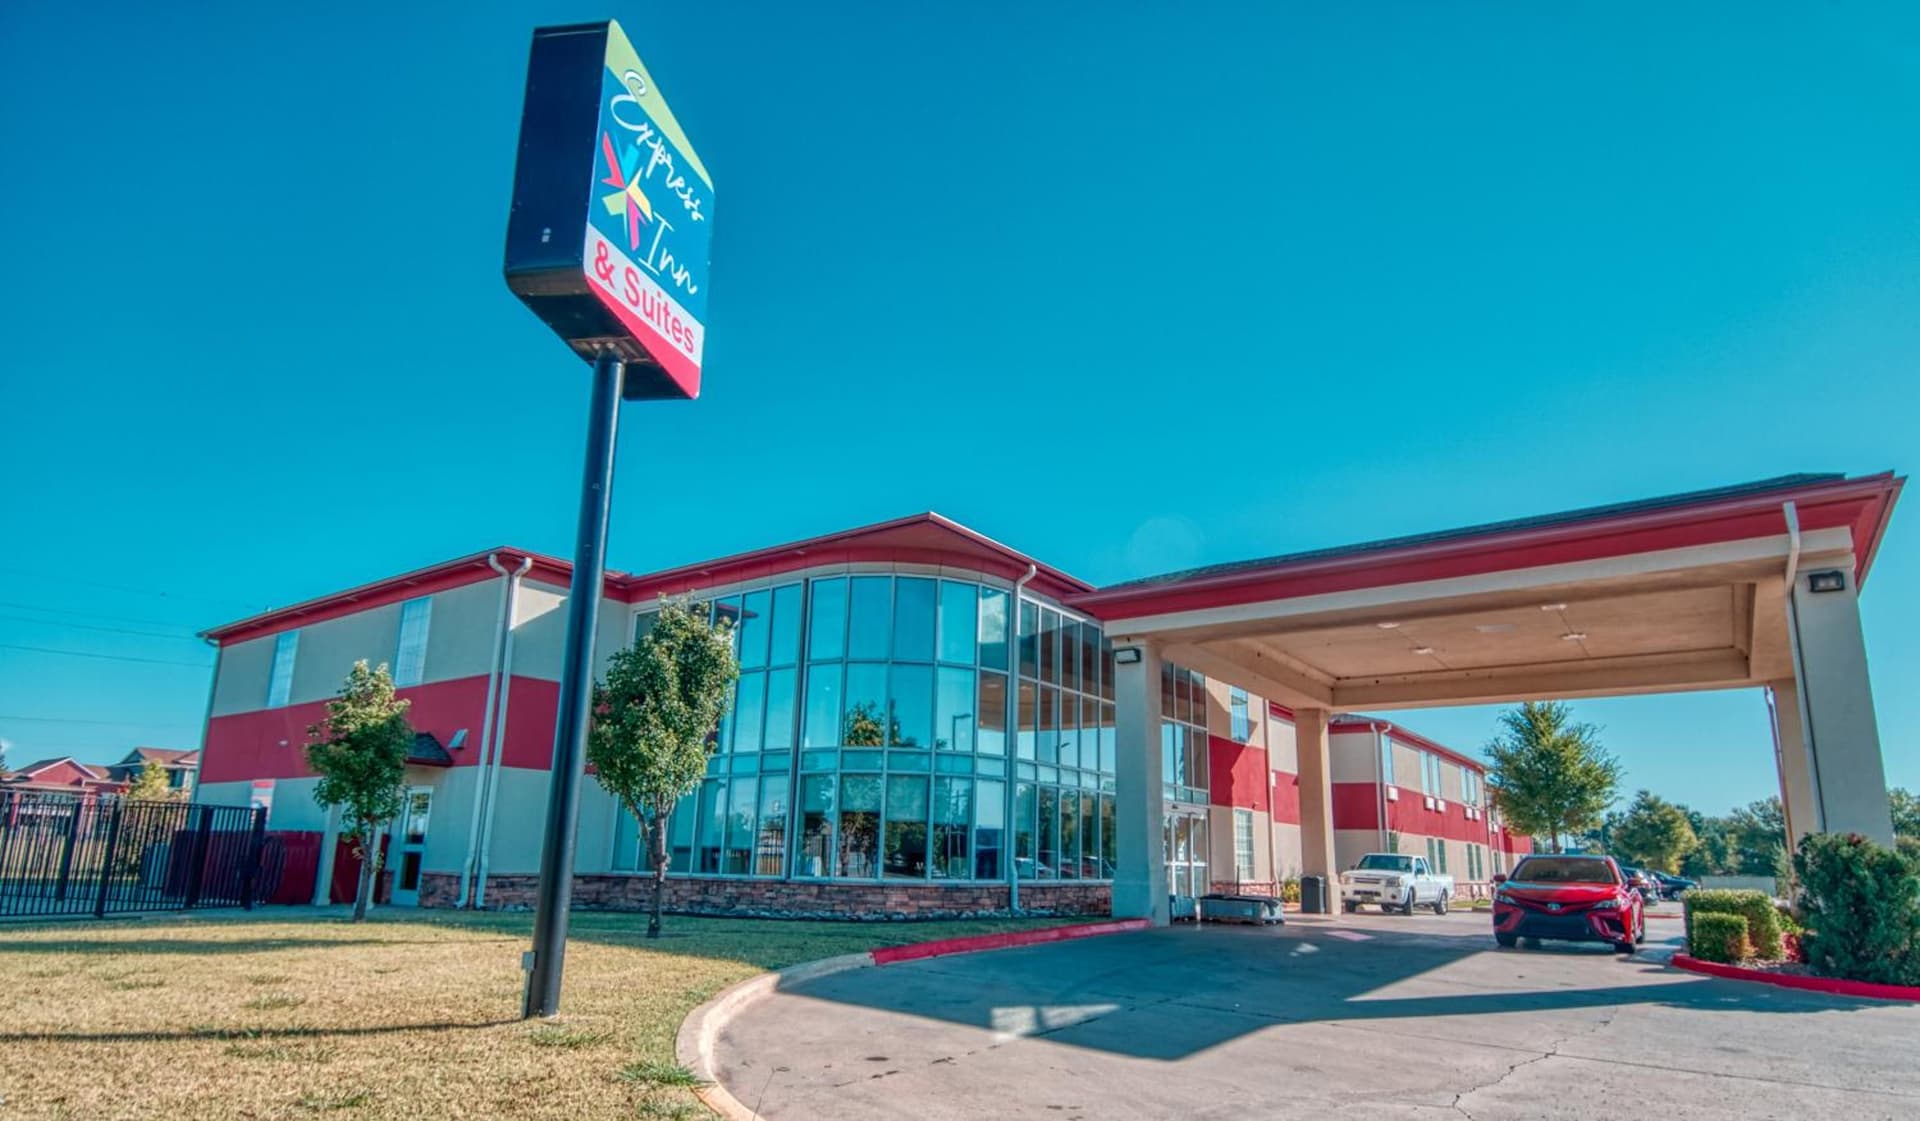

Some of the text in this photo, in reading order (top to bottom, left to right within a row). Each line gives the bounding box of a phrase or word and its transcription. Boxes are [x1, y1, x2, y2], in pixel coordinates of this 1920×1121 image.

[610, 69, 705, 222] Express
[594, 240, 695, 354] & Suites
[638, 211, 698, 295] Inn
